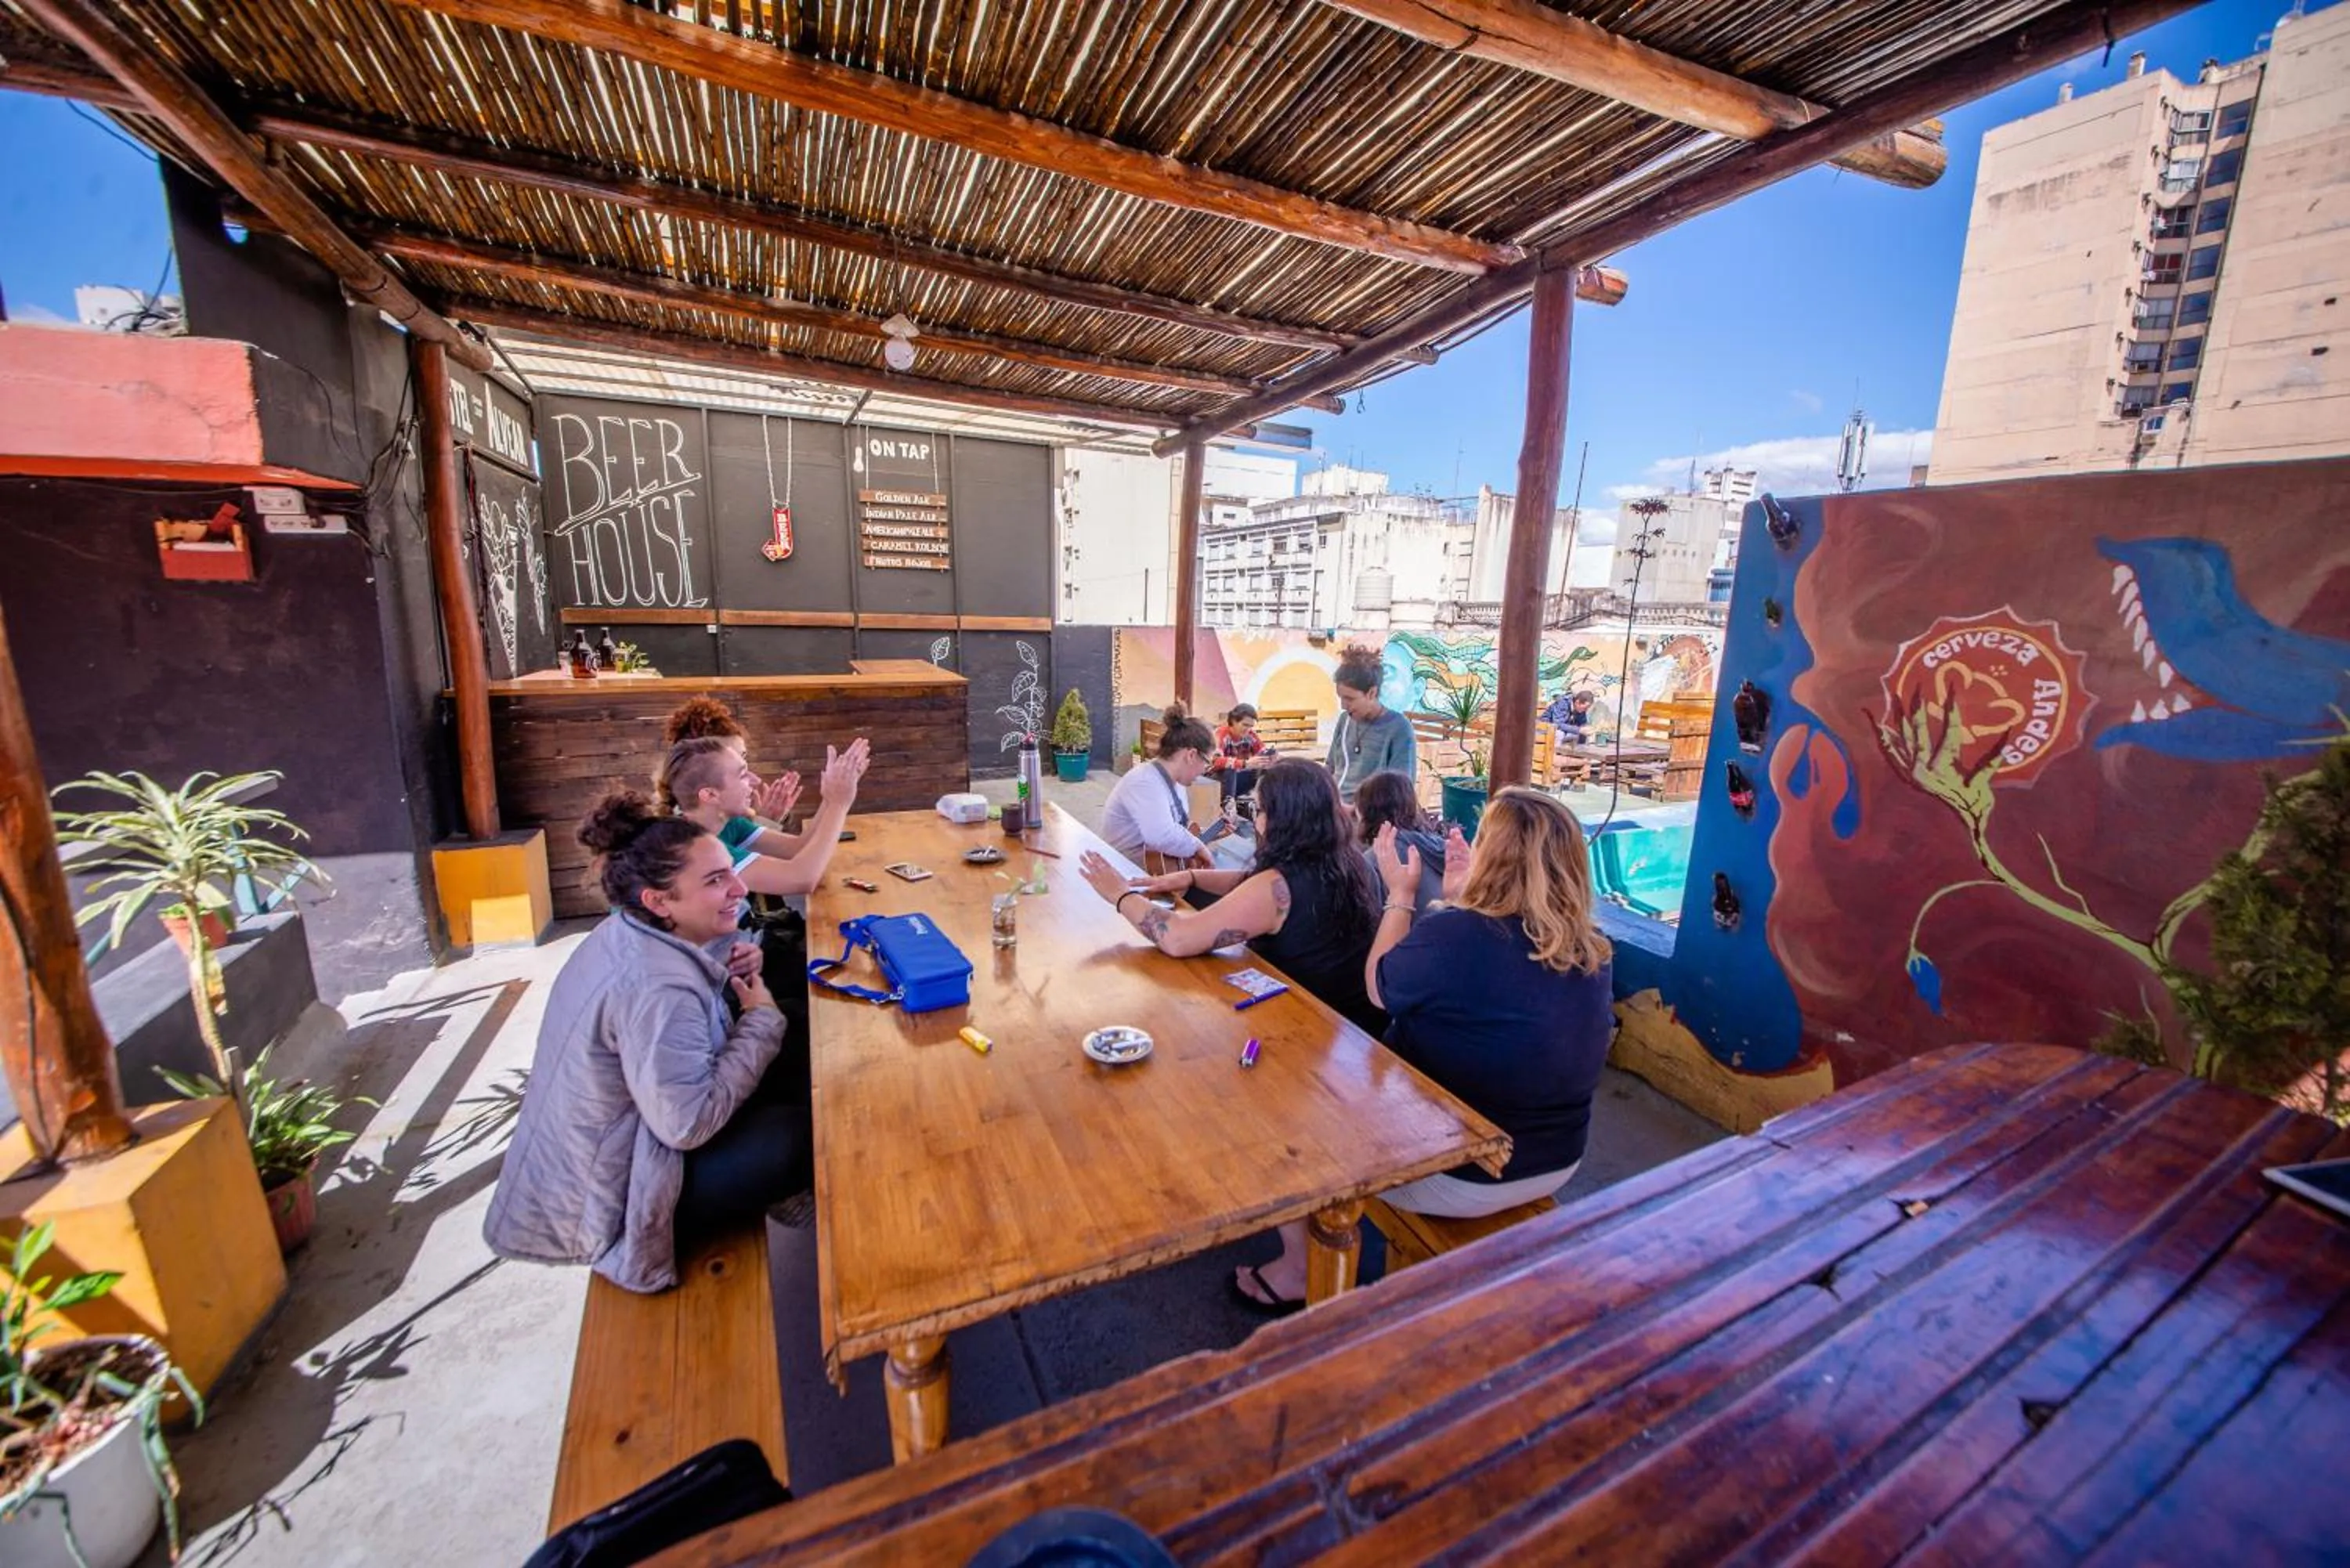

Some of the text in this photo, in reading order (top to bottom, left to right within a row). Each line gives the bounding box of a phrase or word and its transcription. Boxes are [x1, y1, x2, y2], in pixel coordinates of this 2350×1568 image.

[551, 414, 696, 521] BEER
[870, 439, 930, 460] ON TAP
[566, 489, 708, 607] HOUSE
[776, 513, 790, 550] BEER
[1922, 630, 2040, 668] cerveza
[2000, 678, 2063, 764] Andes
